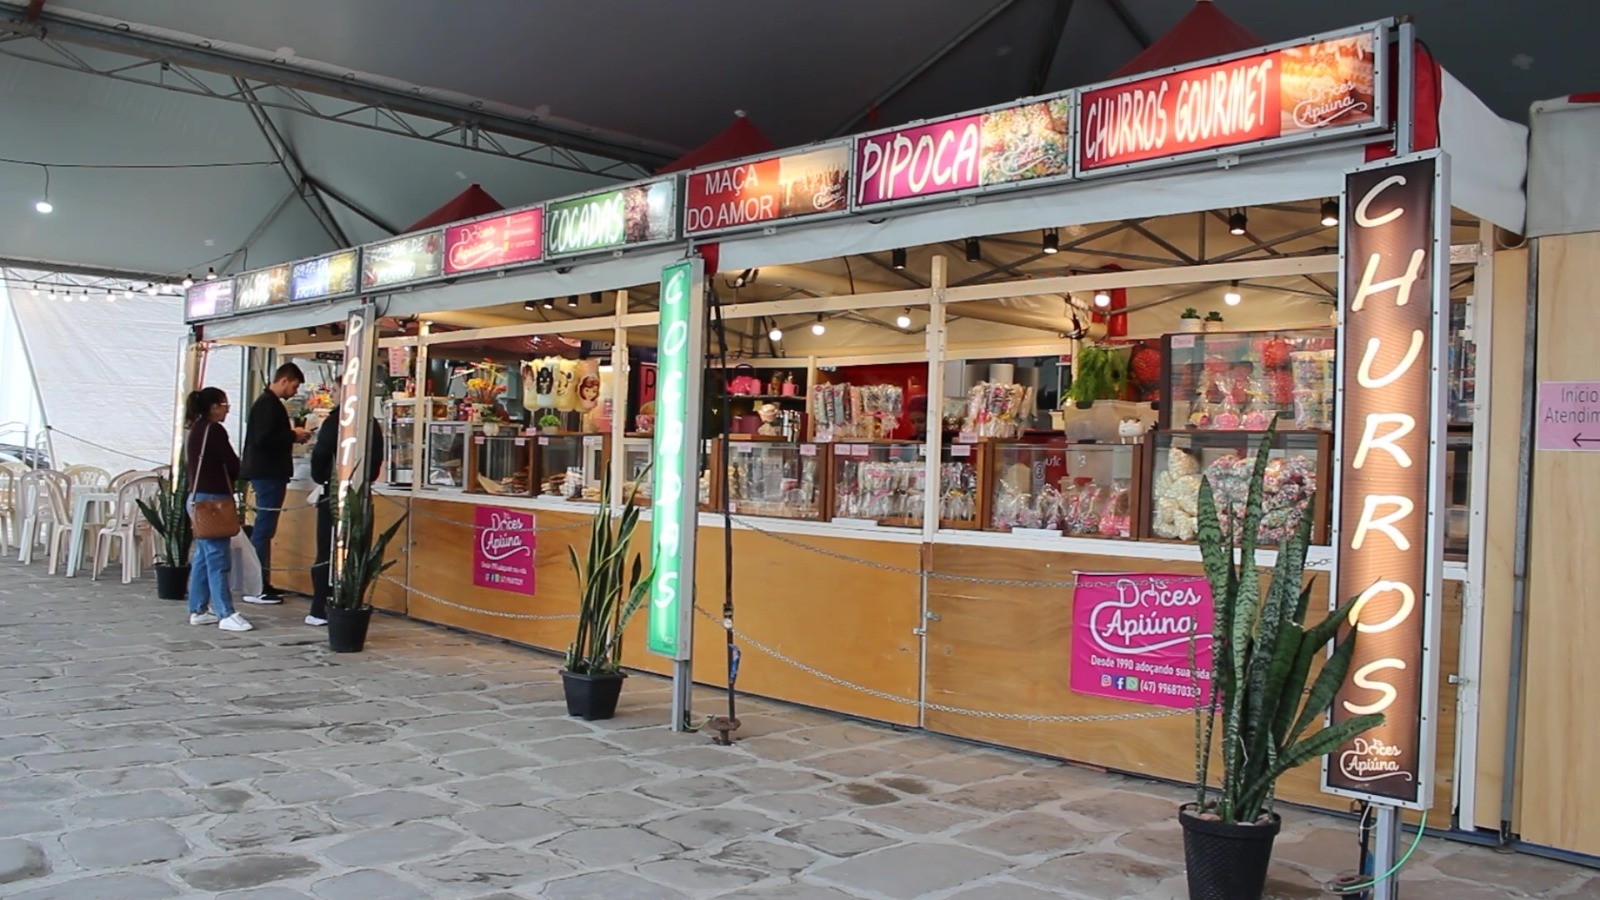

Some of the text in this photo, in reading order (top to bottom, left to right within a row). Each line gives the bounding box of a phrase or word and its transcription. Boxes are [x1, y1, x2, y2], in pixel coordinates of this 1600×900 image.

[1085, 58, 1273, 162] CHURROS GOURMET
[704, 164, 760, 197] MAÇA
[858, 123, 979, 204] PIPOCA
[549, 189, 624, 252] COCADAS
[687, 195, 774, 233] DO AMOR
[654, 270, 687, 609] COCADAS
[1343, 175, 1425, 715] CHURROS
[1116, 577, 1202, 608] Doces
[1102, 609, 1199, 646] Apiúna
[1090, 654, 1115, 668] Desde
[1116, 657, 1134, 670] 1990
[1134, 660, 1174, 676] adoçando
[1175, 667, 1191, 678] sua
[1140, 679, 1156, 695] (47)
[1346, 755, 1399, 776] Apiúna
[1353, 737, 1402, 757] Doces
